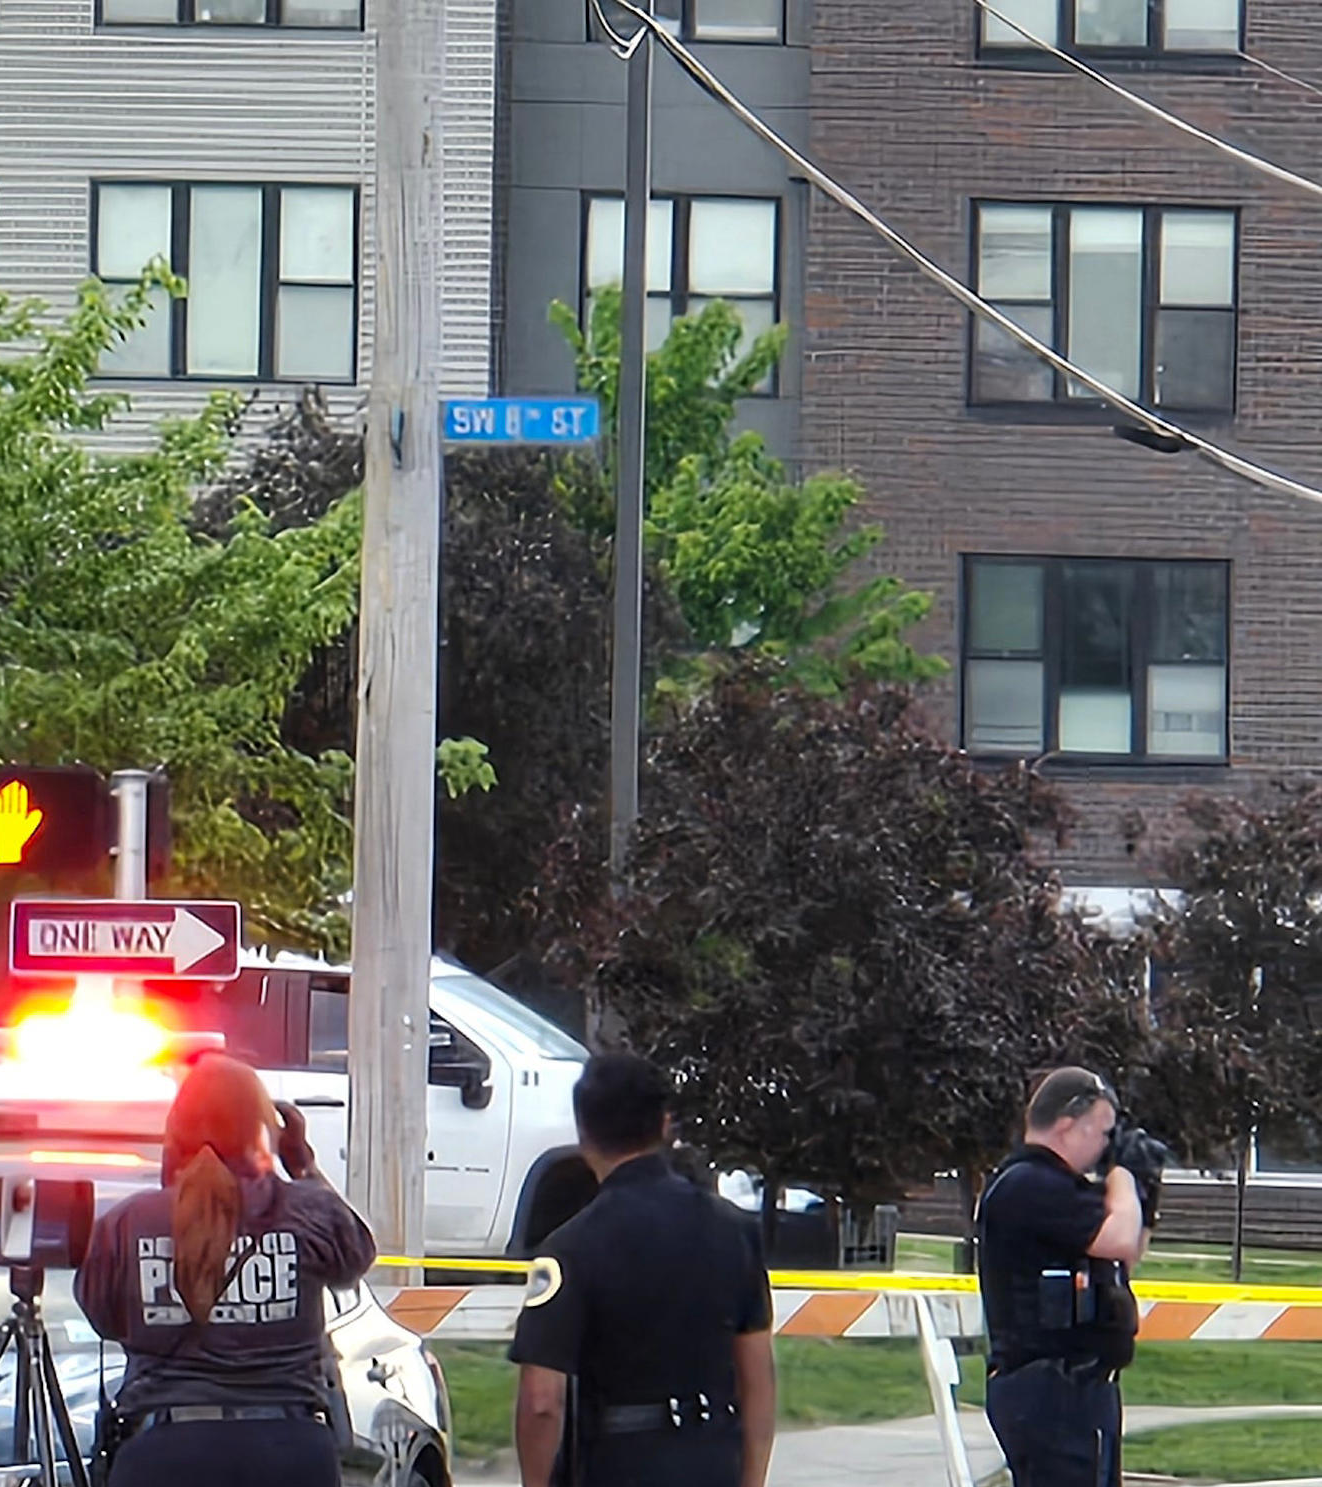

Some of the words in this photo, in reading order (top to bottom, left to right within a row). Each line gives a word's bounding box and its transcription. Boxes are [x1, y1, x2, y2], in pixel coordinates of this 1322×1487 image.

[452, 405, 495, 435] SW
[112, 924, 172, 952] WAY
[139, 1252, 297, 1304] PICE
